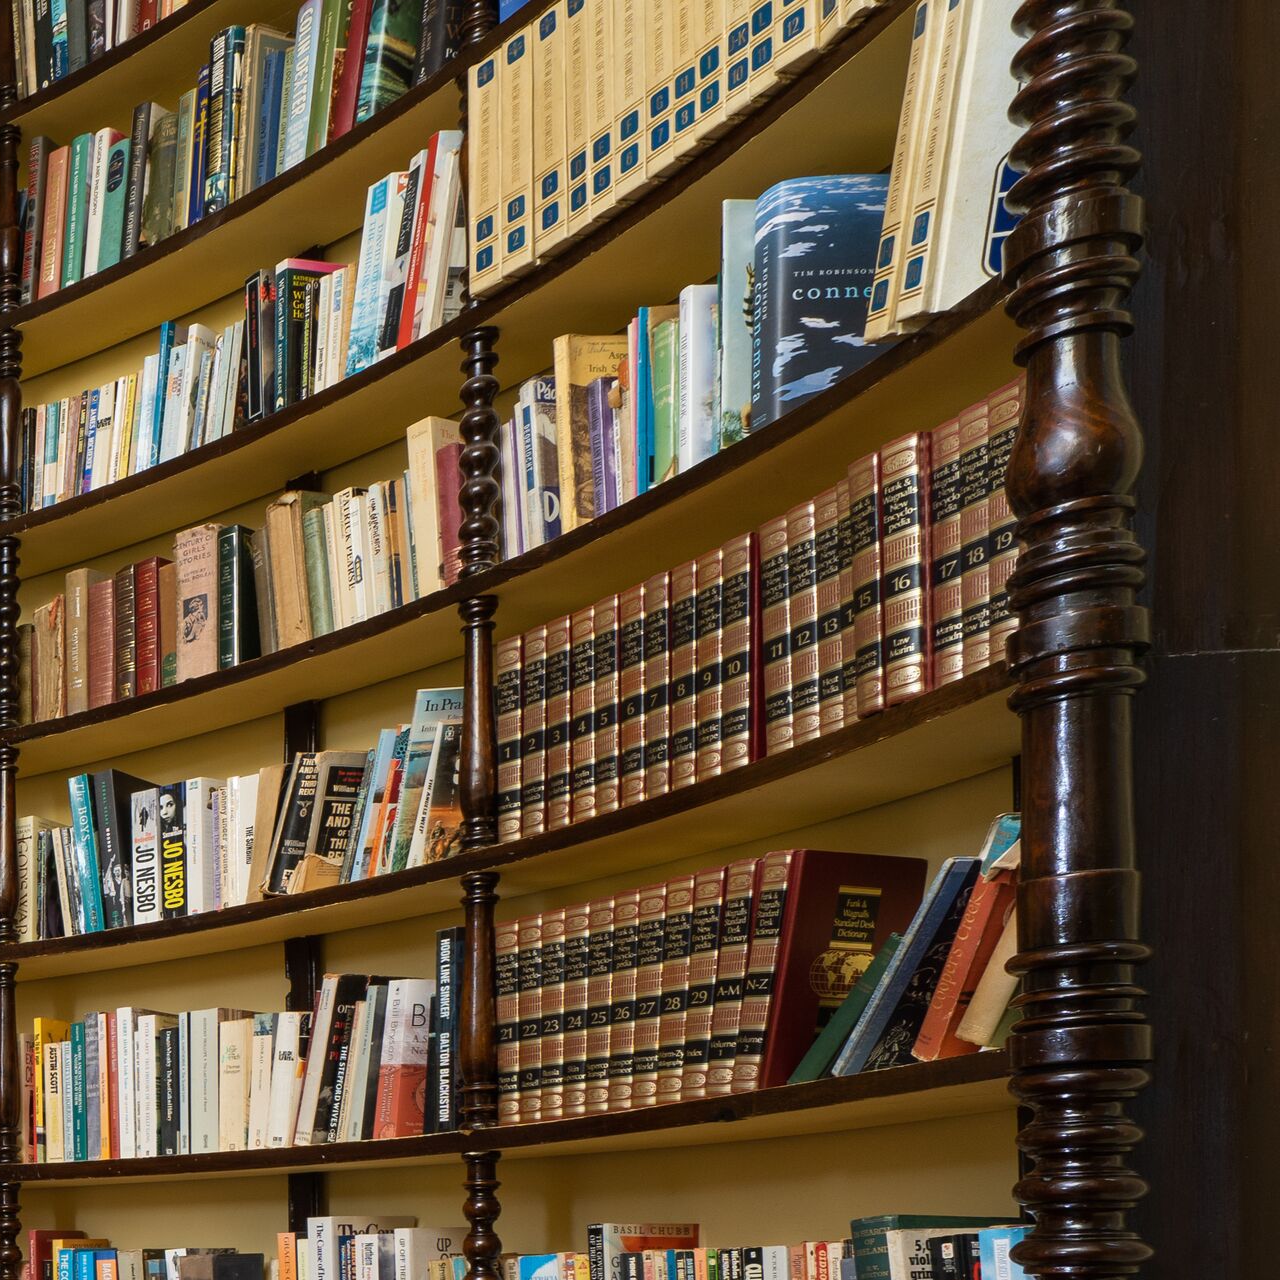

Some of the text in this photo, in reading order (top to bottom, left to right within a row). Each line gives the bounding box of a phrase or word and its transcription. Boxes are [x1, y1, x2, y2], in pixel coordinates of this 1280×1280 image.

[291, 7, 314, 118] COLIN DEXTER
[793, 268, 875, 277] TIM ROBINSON
[752, 282, 763, 402] connemara
[342, 491, 356, 591] PATRICK PEARSE
[966, 547, 984, 565] 18
[939, 560, 957, 578] 17
[891, 574, 911, 591] 16
[163, 839, 185, 910] JO NESBO
[441, 938, 451, 963] HOOK
[441, 964, 450, 984] LINE
[716, 983, 740, 998] A-M
[746, 978, 769, 991] N-Z
[664, 997, 681, 1011] 28
[692, 990, 708, 1005] 29
[440, 1032, 450, 1064] GALTON
[439, 1065, 450, 1123] BLACKISTON
[613, 1225, 690, 1235] BASIL CHUBB
[60, 1254, 69, 1270] THE
